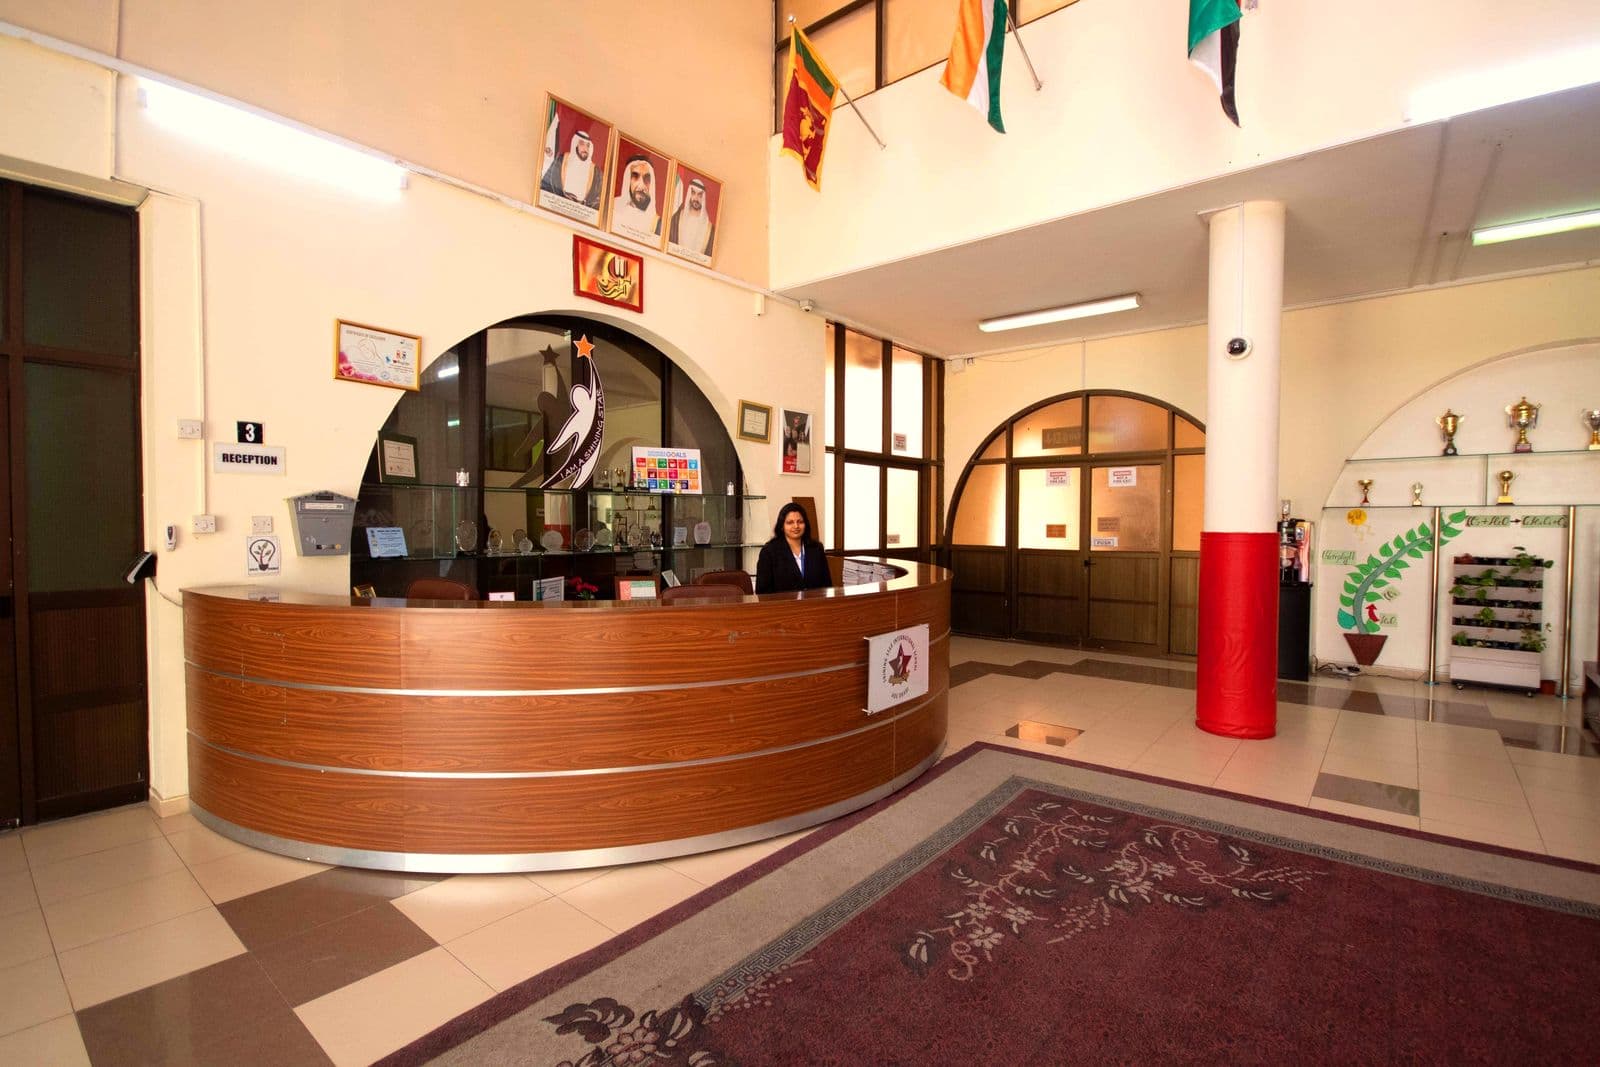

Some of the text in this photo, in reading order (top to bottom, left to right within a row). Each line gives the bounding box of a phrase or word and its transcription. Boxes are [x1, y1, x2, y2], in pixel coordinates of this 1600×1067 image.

[245, 423, 255, 442] 3
[565, 464, 578, 475] AM
[584, 420, 604, 458] SHINING
[596, 389, 604, 419] STAR
[222, 453, 277, 465] RECEPTION
